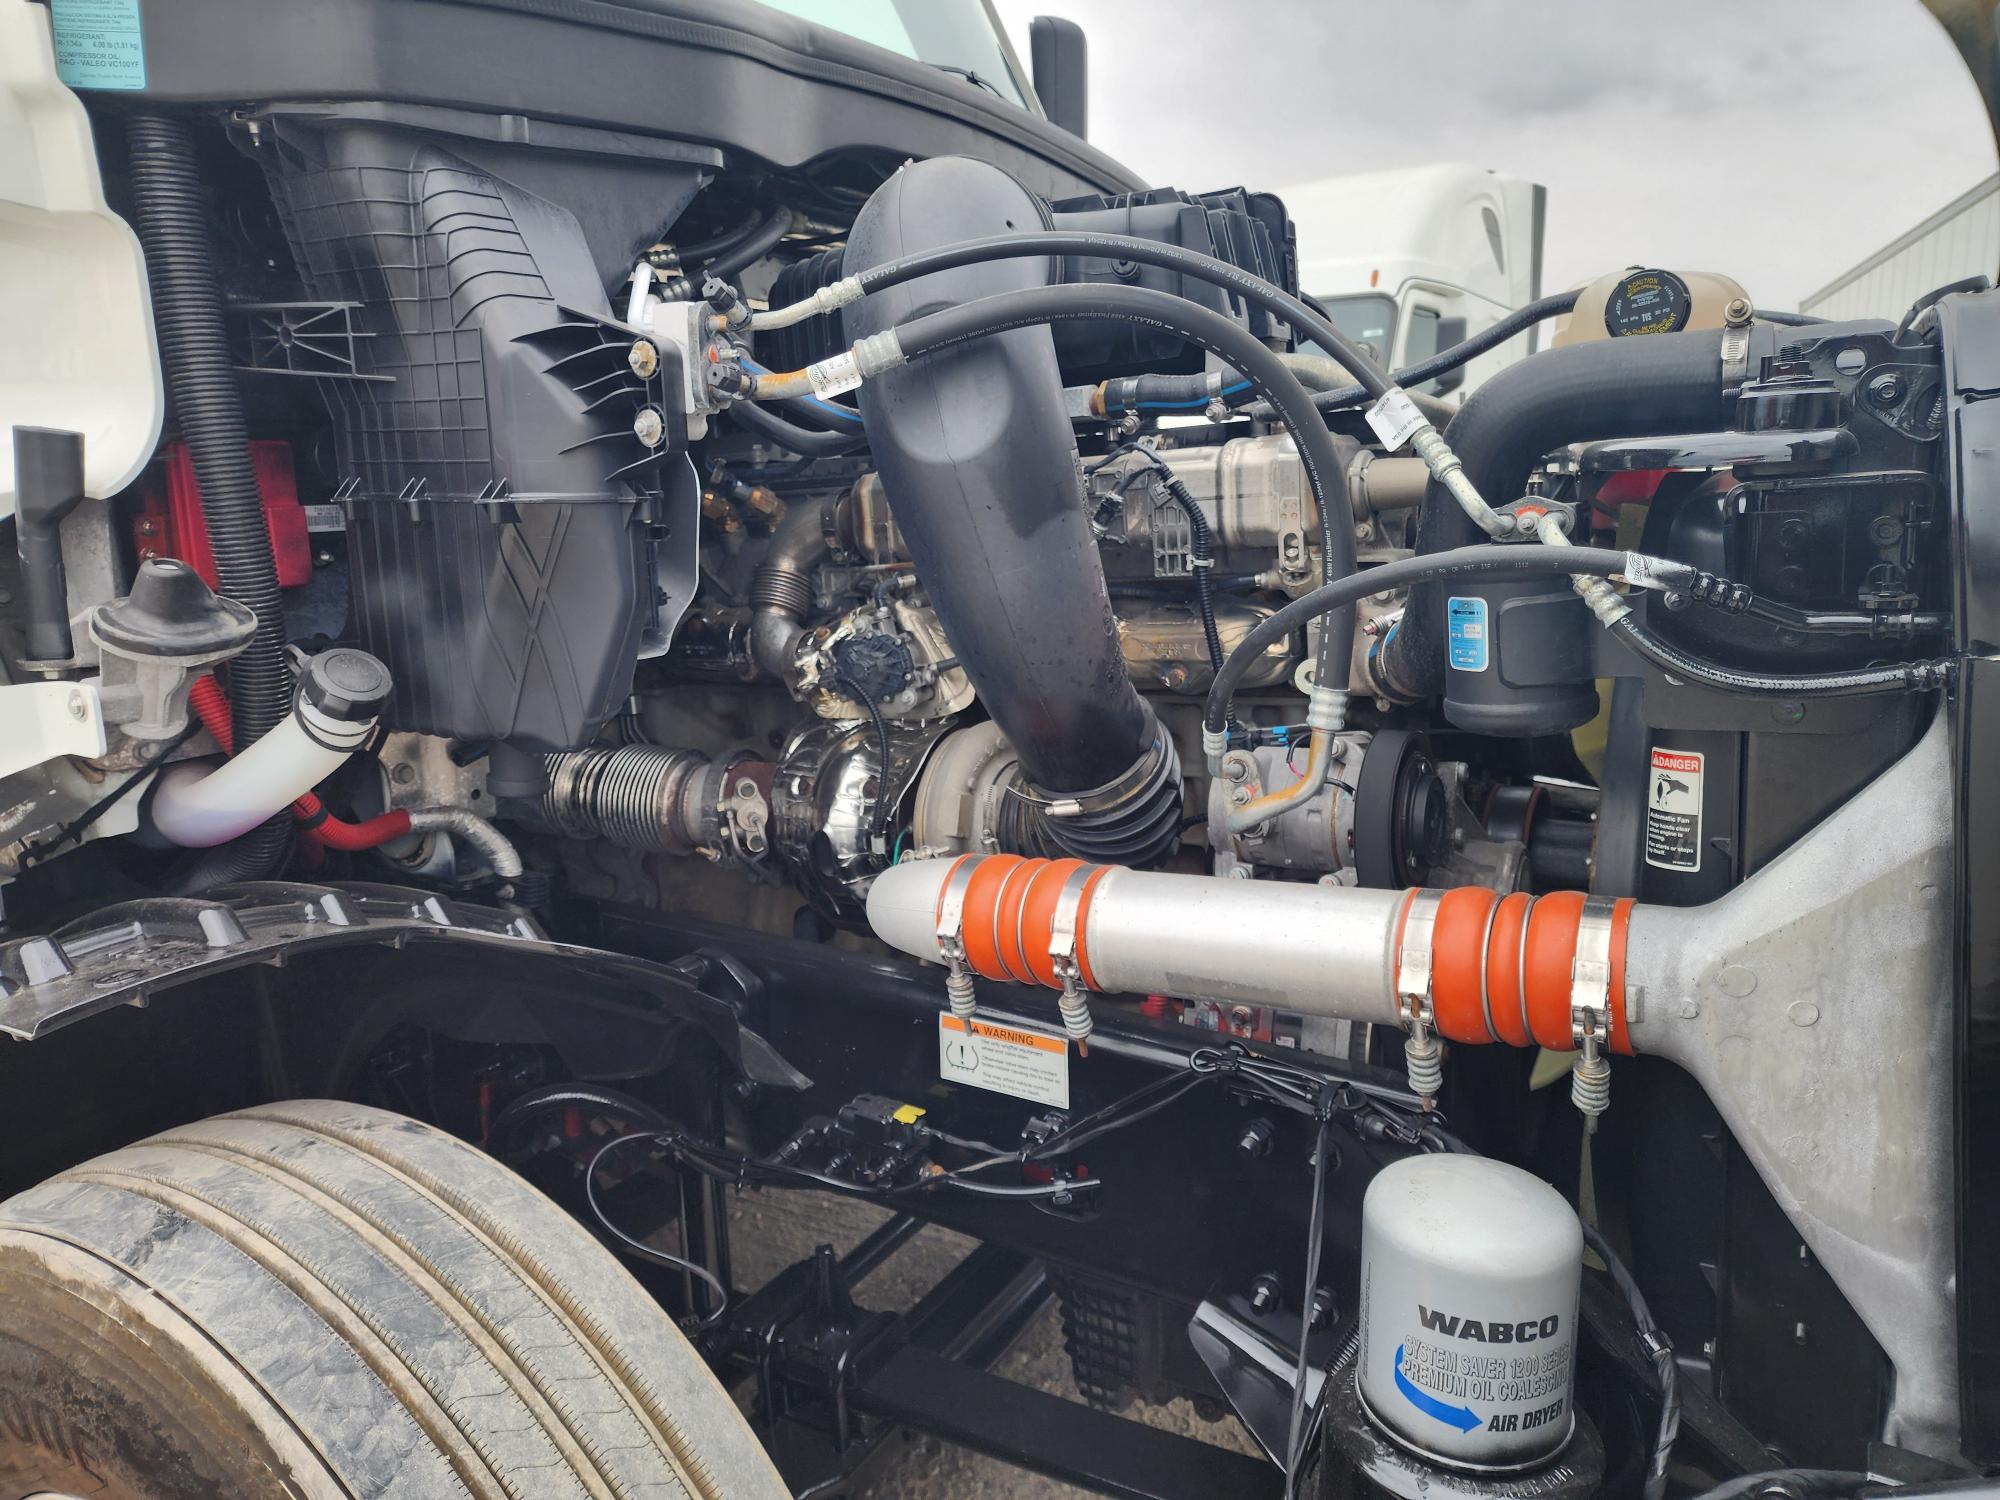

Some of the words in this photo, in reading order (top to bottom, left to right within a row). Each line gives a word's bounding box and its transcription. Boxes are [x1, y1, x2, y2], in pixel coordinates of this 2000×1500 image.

[1632, 277, 1658, 287] CAUTION
[1128, 315, 1162, 327] GALAXY
[1294, 428, 1304, 446] HOSE
[1302, 444, 1315, 470] SUCTION
[1326, 530, 1334, 564] FlexBarrier
[1659, 757, 1699, 771] DANGER
[1650, 812, 1676, 823] Automatic
[1677, 815, 1690, 824] Fan
[1660, 829, 1677, 837] engine
[1656, 843, 1669, 851] starts
[1677, 846, 1694, 854] stops
[984, 1026, 1034, 1046] WARNING
[1418, 1304, 1559, 1344] WABCO
[1404, 1334, 1458, 1374] SYSTEM
[1460, 1354, 1506, 1380] SAVER
[1510, 1355, 1540, 1380] 1200
[1541, 1342, 1570, 1373] SERIES
[1403, 1356, 1467, 1398] PREMIUM
[1470, 1379, 1495, 1402] OIL
[1488, 1414, 1520, 1432] AIR
[1522, 1398, 1564, 1430] DRYER
